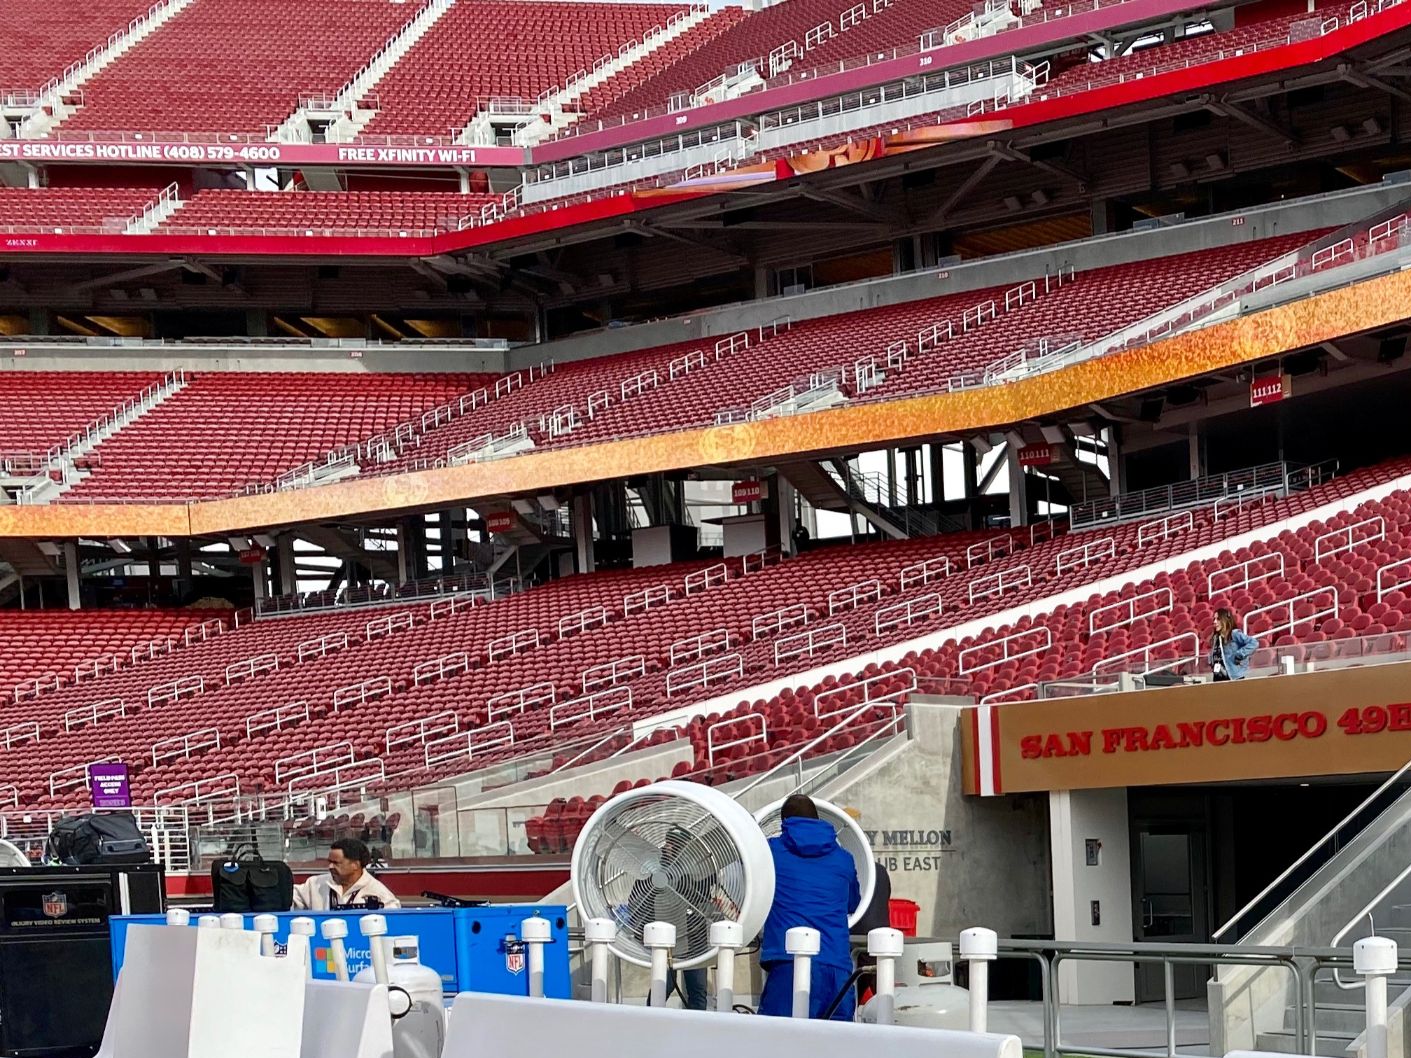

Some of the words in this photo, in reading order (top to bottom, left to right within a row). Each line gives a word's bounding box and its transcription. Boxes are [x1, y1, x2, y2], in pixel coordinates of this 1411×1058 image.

[22, 144, 94, 158] SERVICES
[96, 145, 161, 159] HOTLINE
[163, 145, 205, 160] (408)
[207, 146, 281, 161] 579-4600
[338, 147, 375, 161] FREE
[377, 148, 435, 162] XFINITY
[437, 149, 476, 163] WI-FI
[1020, 730, 1093, 760] SAN
[1101, 711, 1328, 755] FRANCISCO
[882, 829, 952, 846] MELLON
[903, 855, 942, 872] EAST
